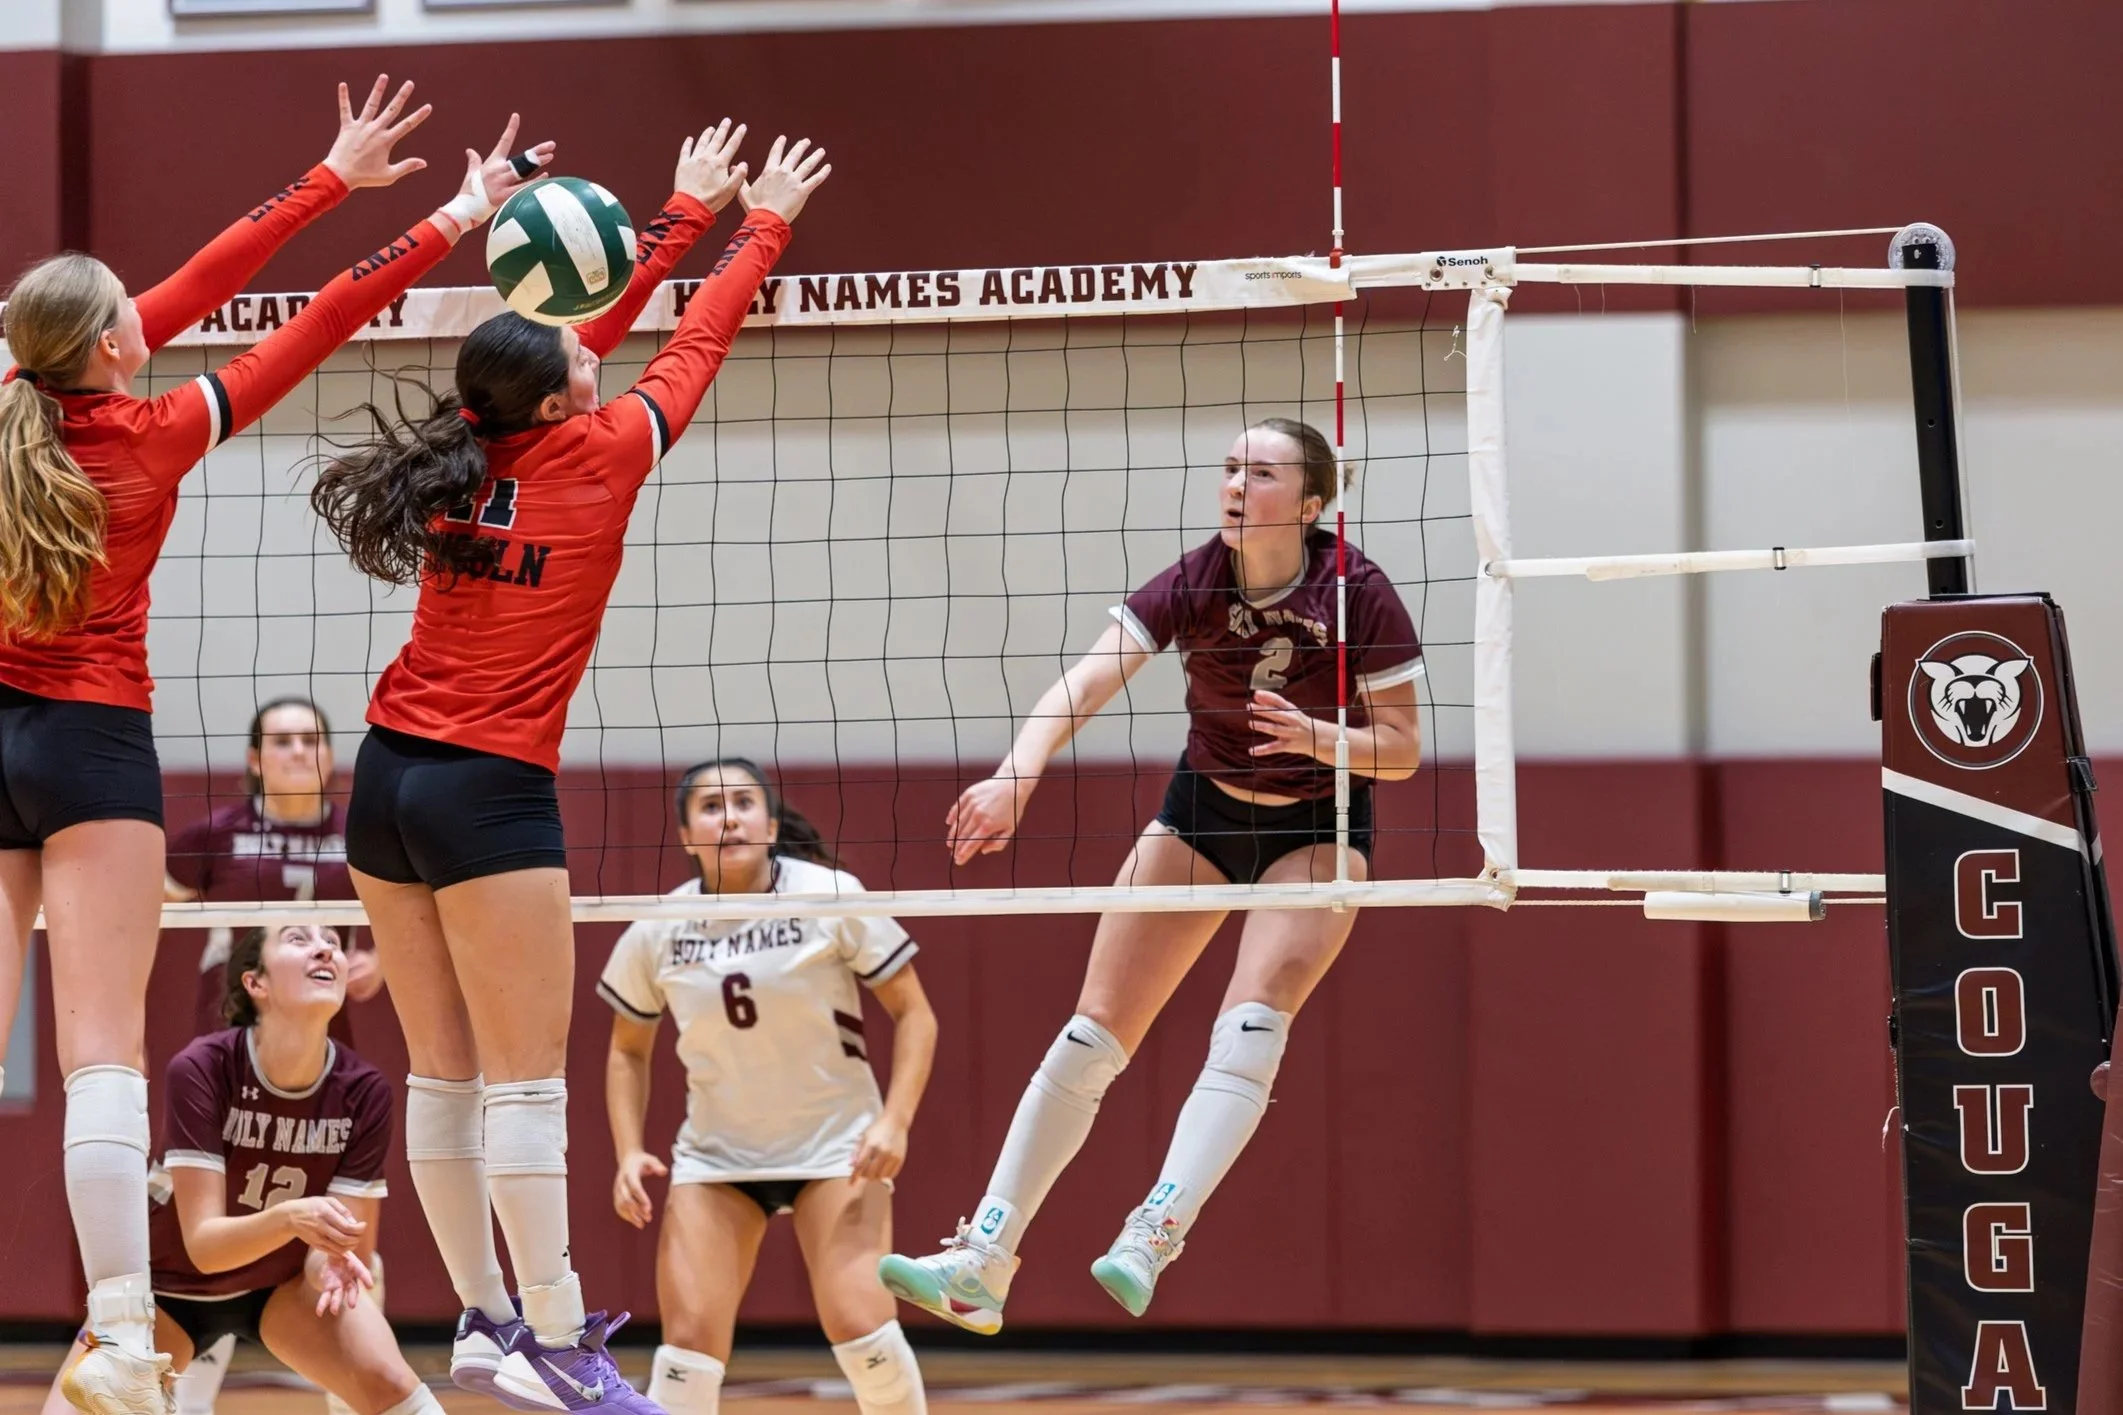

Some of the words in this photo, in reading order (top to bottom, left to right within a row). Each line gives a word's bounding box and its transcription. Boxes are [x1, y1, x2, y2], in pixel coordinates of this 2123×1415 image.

[1245, 272, 1271, 281] sports
[1447, 256, 1489, 267] Senoh
[673, 278, 782, 317] HY
[799, 271, 961, 313] NAMES
[979, 263, 1198, 306] ACADEMY
[200, 292, 408, 332] ACADY
[1249, 637, 1295, 691] 2
[281, 865, 318, 901] 7
[726, 917, 804, 958] NAMES
[721, 971, 759, 1030] 6
[237, 1162, 308, 1211] 12
